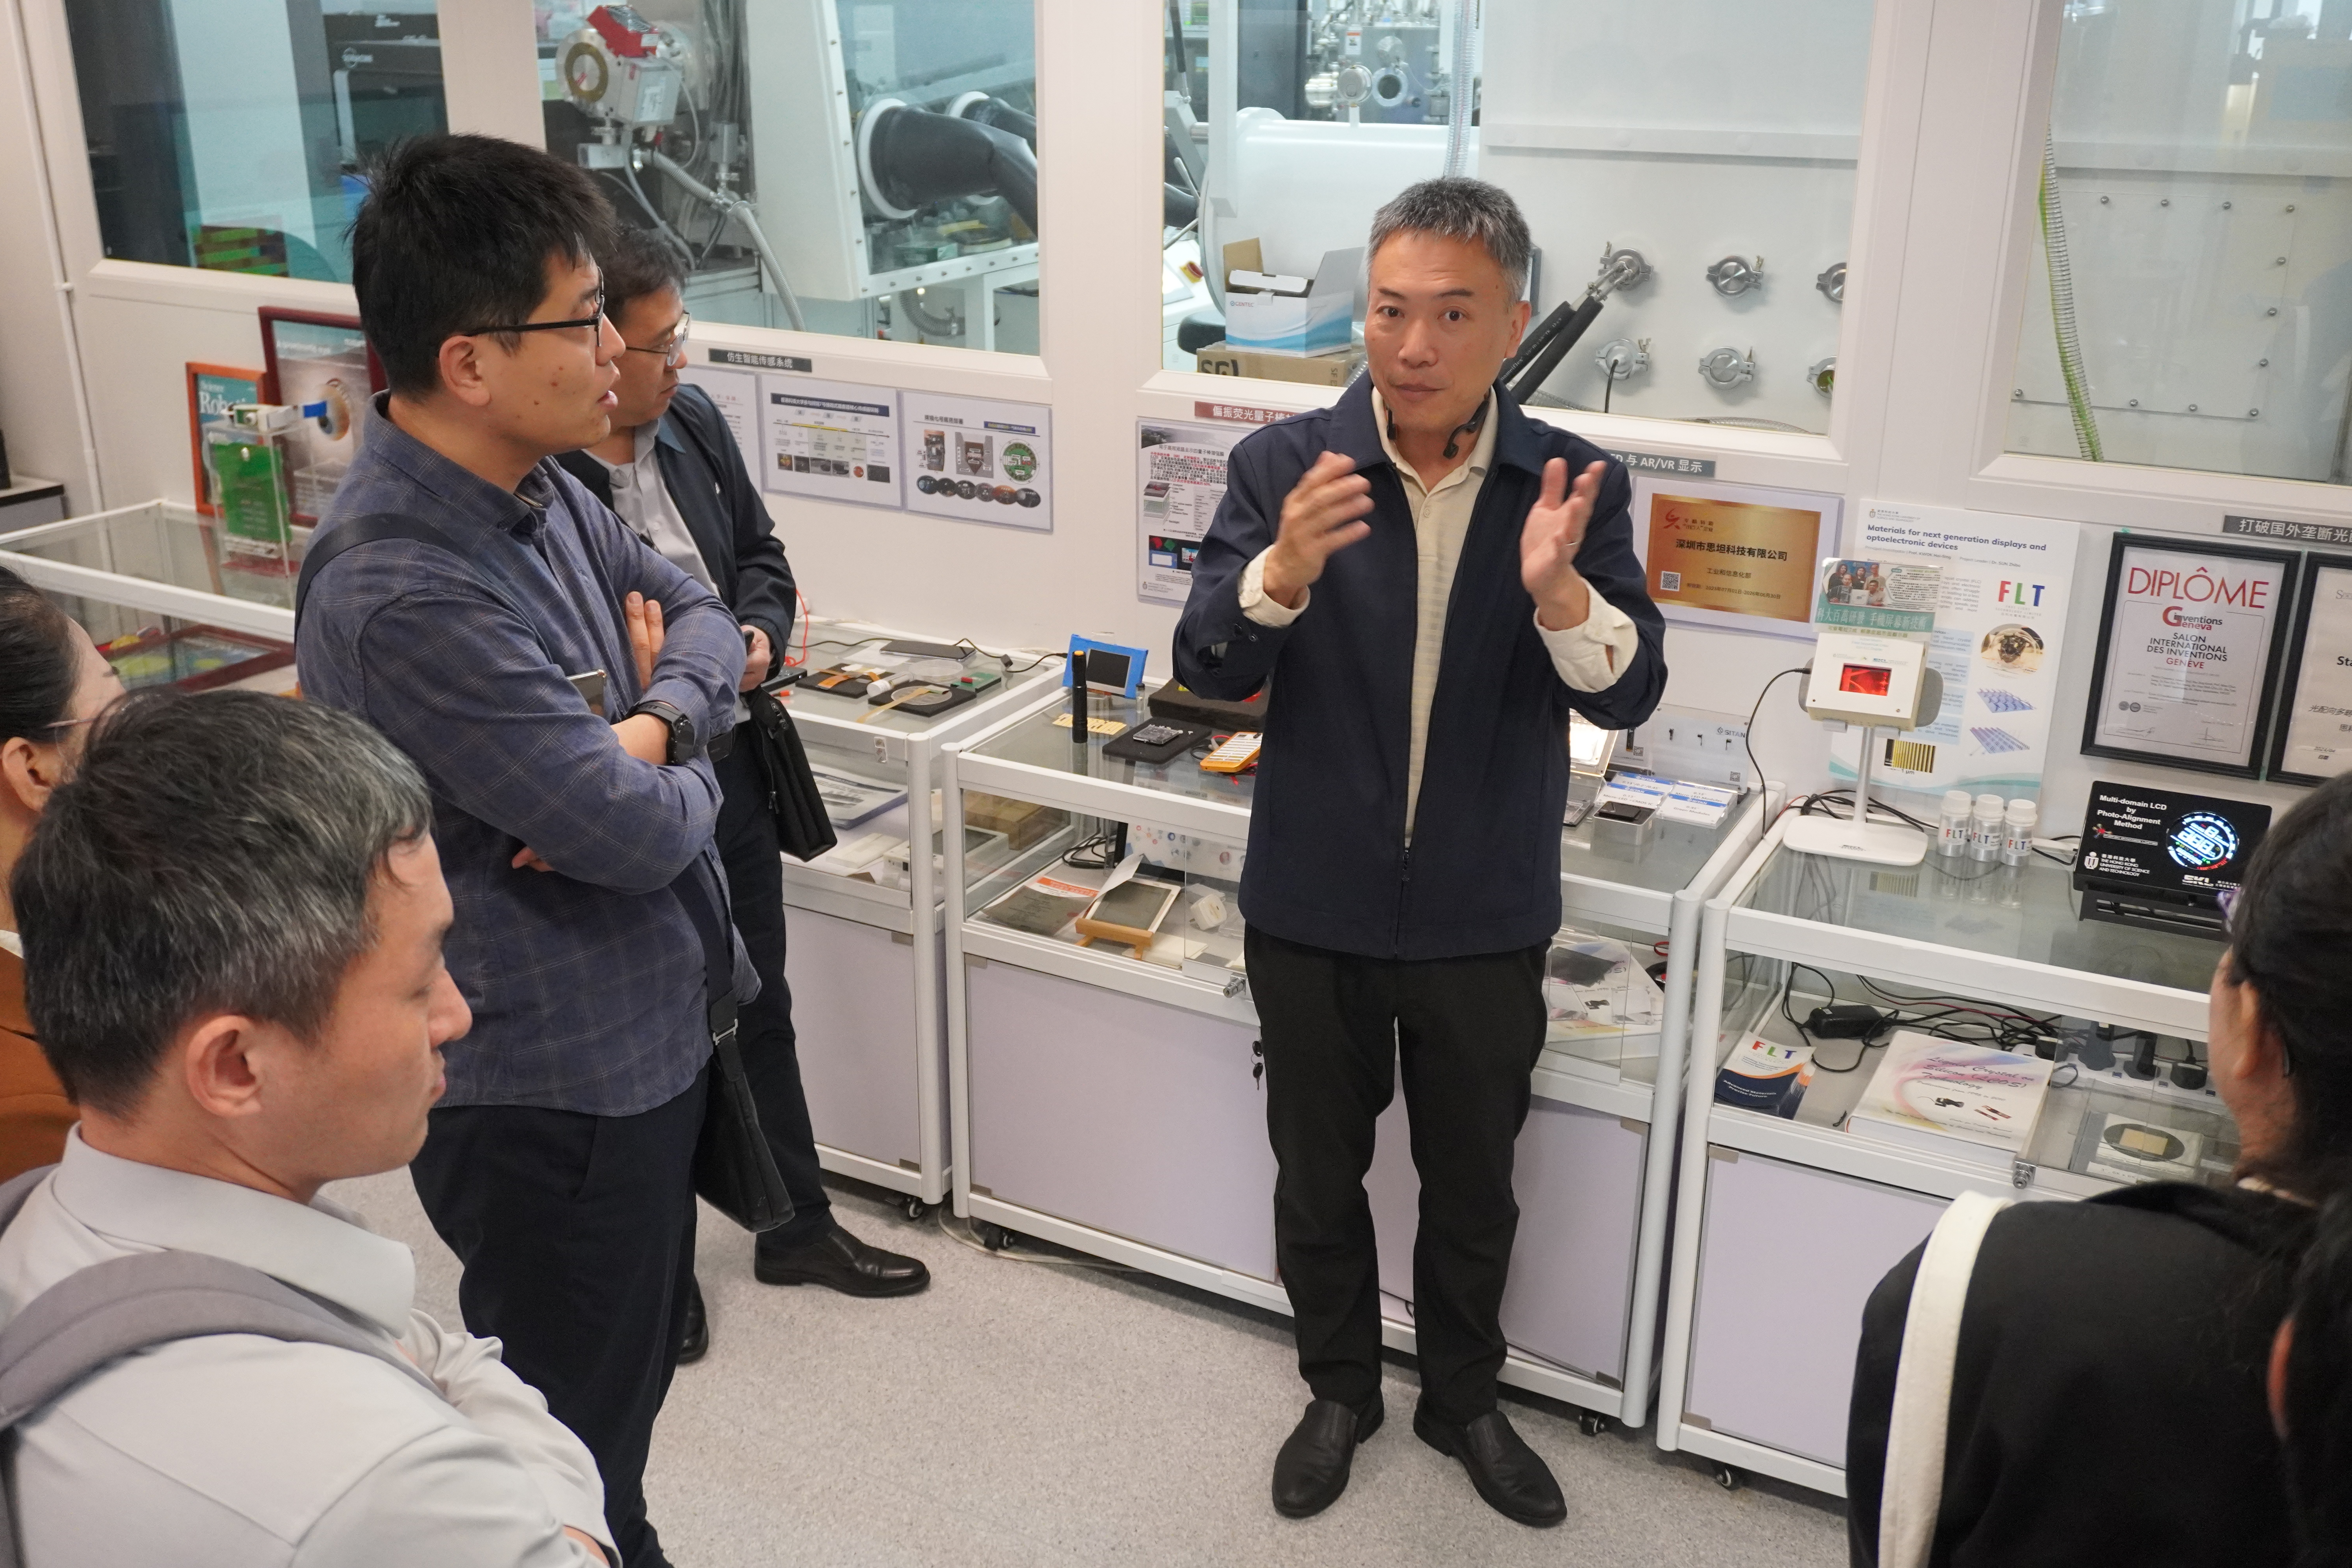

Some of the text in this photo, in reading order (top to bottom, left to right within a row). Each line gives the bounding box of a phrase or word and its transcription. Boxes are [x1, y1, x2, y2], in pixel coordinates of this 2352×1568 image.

[727, 352, 793, 368] 仿生智能传感系统
[1626, 454, 1638, 466] 与
[1640, 457, 1675, 470] AR/VR
[1678, 459, 1703, 473] 显示
[1868, 524, 1906, 534] Materials
[1923, 530, 1941, 539] next
[1944, 533, 1989, 544] generation
[1992, 538, 2027, 550] displays
[2029, 543, 2047, 551] and
[2239, 519, 2352, 543] 打破国外垄断光
[1676, 538, 1788, 561] 深圳市思坦科技有限公司
[1866, 535, 1958, 550] optoelectronic devices
[1707, 568, 1751, 579] 工业和信息化部
[1998, 581, 2045, 607] FLT
[2128, 566, 2269, 609] DIPLÔME
[2162, 606, 2212, 631] Geneva
[2173, 632, 2206, 643] SALON
[2150, 637, 2227, 654] INTERNATIONAL
[2147, 645, 2228, 662] DES INVENTIONS
[2167, 657, 2205, 669] GENÈVE
[2100, 795, 2149, 808] Multi-domain
[2097, 809, 2161, 825] Photo-Alignment
[2114, 820, 2143, 829] Method
[1946, 829, 1963, 839] FLT
[1973, 832, 1989, 844] FLT
[2008, 840, 2026, 850] FLT
[1752, 1040, 1797, 1059] FLT
[1927, 1057, 1972, 1068] Liquid
[1924, 1065, 1965, 1076] Silicon
[1972, 1066, 2019, 1078] Crystal
[1723, 1080, 1750, 1093] Advanced
[1922, 1072, 1983, 1090] Technology
[1728, 1085, 1749, 1096] Precise
